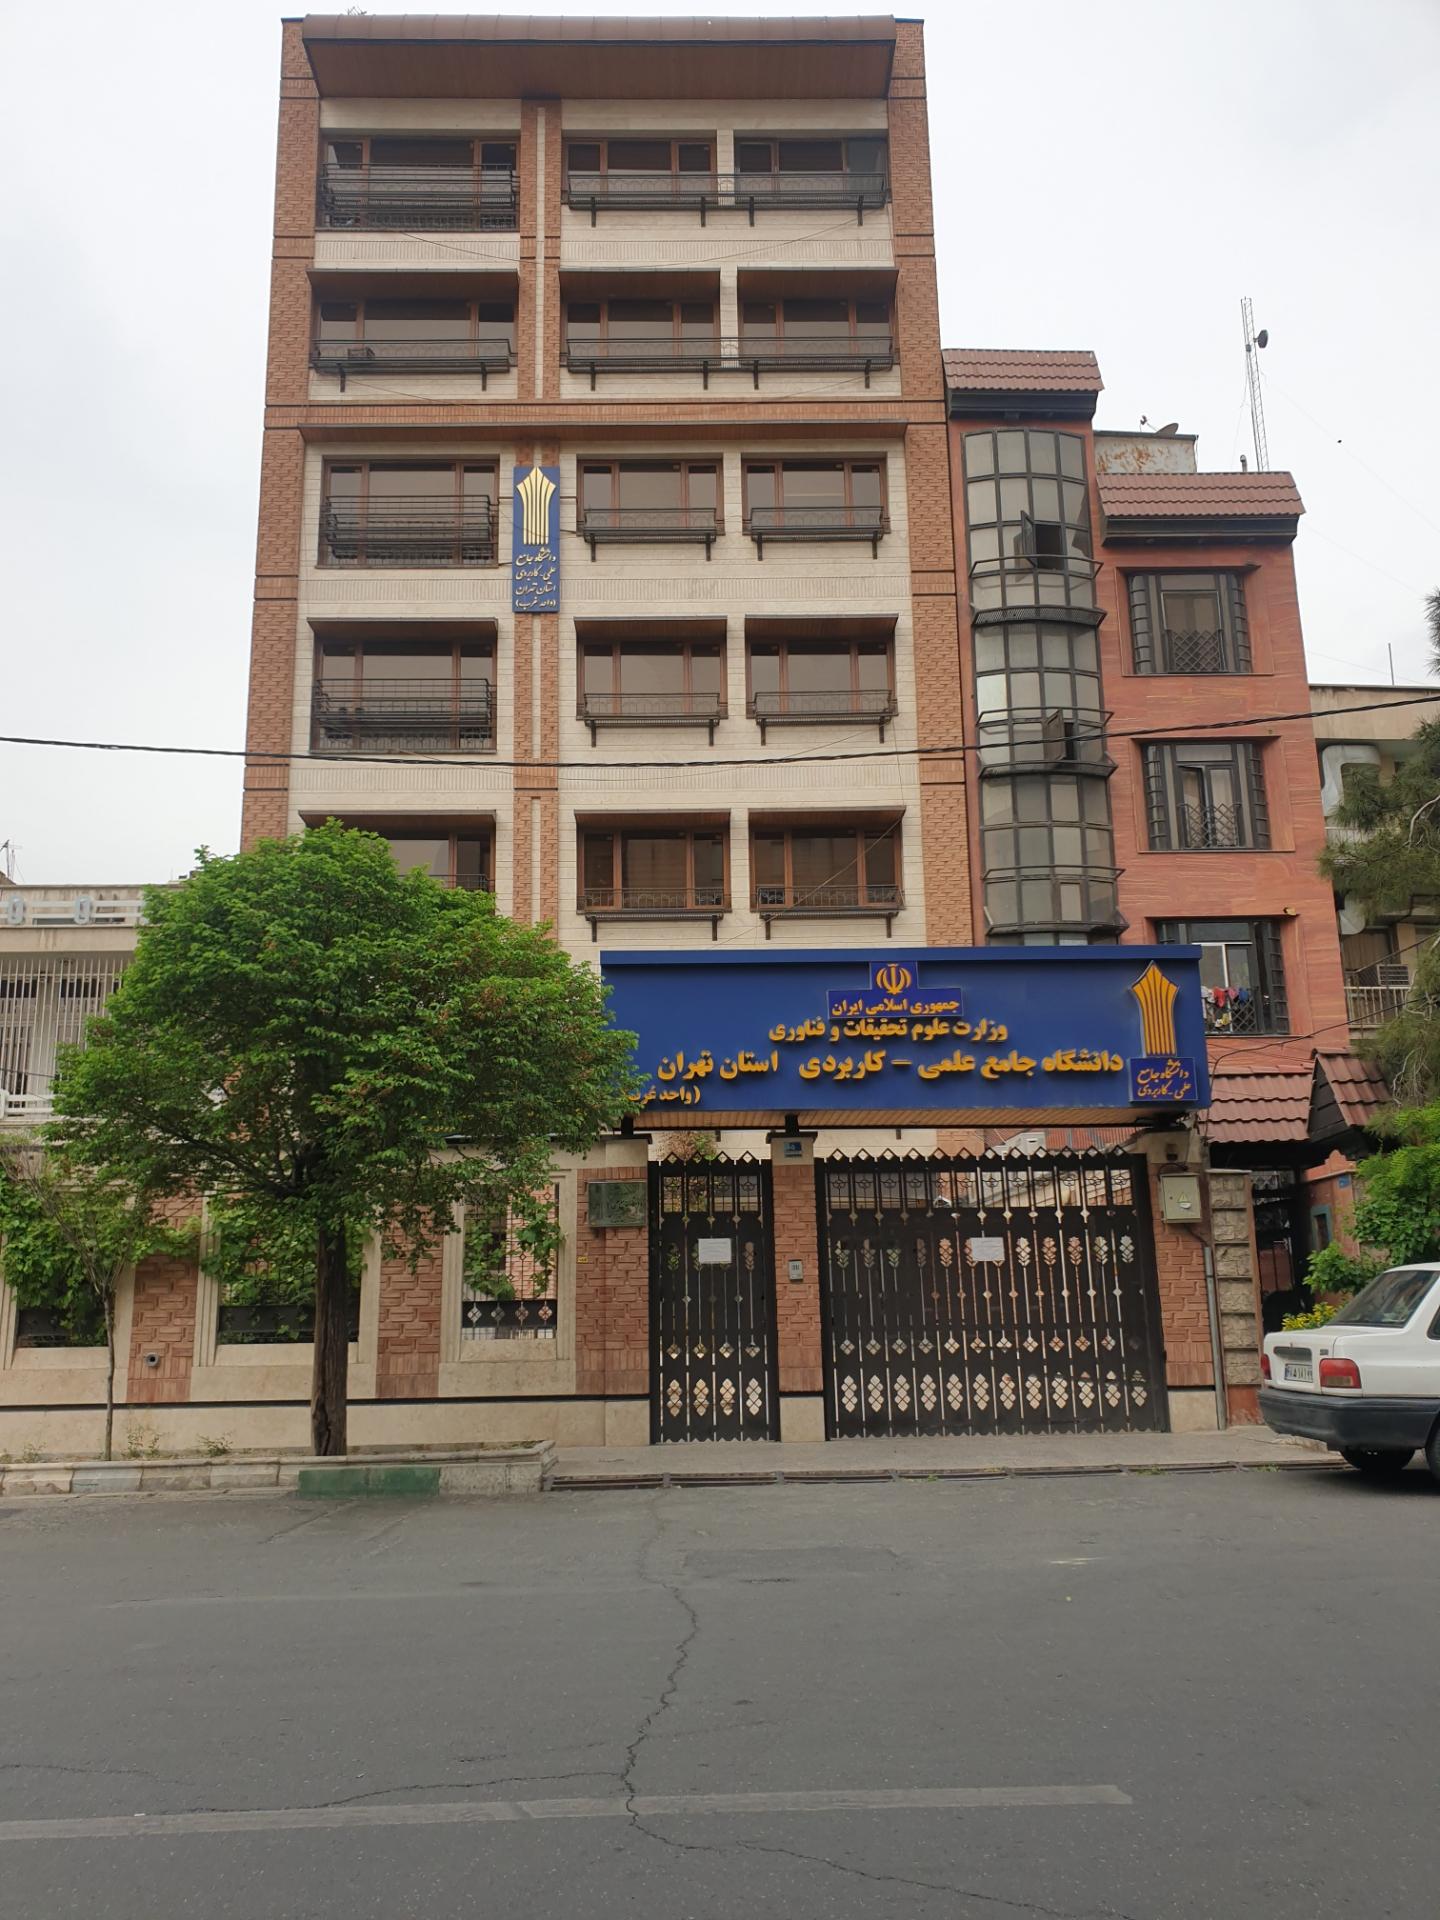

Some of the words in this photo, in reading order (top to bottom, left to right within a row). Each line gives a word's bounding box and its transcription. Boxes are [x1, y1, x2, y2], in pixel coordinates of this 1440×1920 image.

[515, 554, 533, 566] جامع
[534, 547, 556, 561] دانشگاه
[515, 565, 543, 581] کاربردی
[543, 567, 556, 580] علمی
[515, 582, 538, 595] تهران
[536, 581, 556, 595] استان
[831, 999, 863, 1016] ایران
[865, 998, 908, 1015] اسلامی
[910, 1000, 960, 1014] جمهوری
[768, 1017, 826, 1041] فناوری
[828, 1024, 840, 1041] و
[843, 1019, 907, 1041] تحقیقات
[911, 1018, 950, 1041] علوم
[952, 1018, 1008, 1041] وزارت
[657, 1050, 714, 1080] تهران
[719, 1050, 779, 1080] استان
[799, 1050, 887, 1080] کاربردی
[917, 1050, 976, 1079] علمی
[980, 1050, 1037, 1079] جامع
[1041, 1048, 1124, 1072] دانشگاه
[1160, 1059, 1190, 1079] دانشگاه
[1137, 1068, 1160, 1084] جامع
[1137, 1080, 1173, 1098] کاربردی
[1174, 1081, 1192, 1099] علمی
